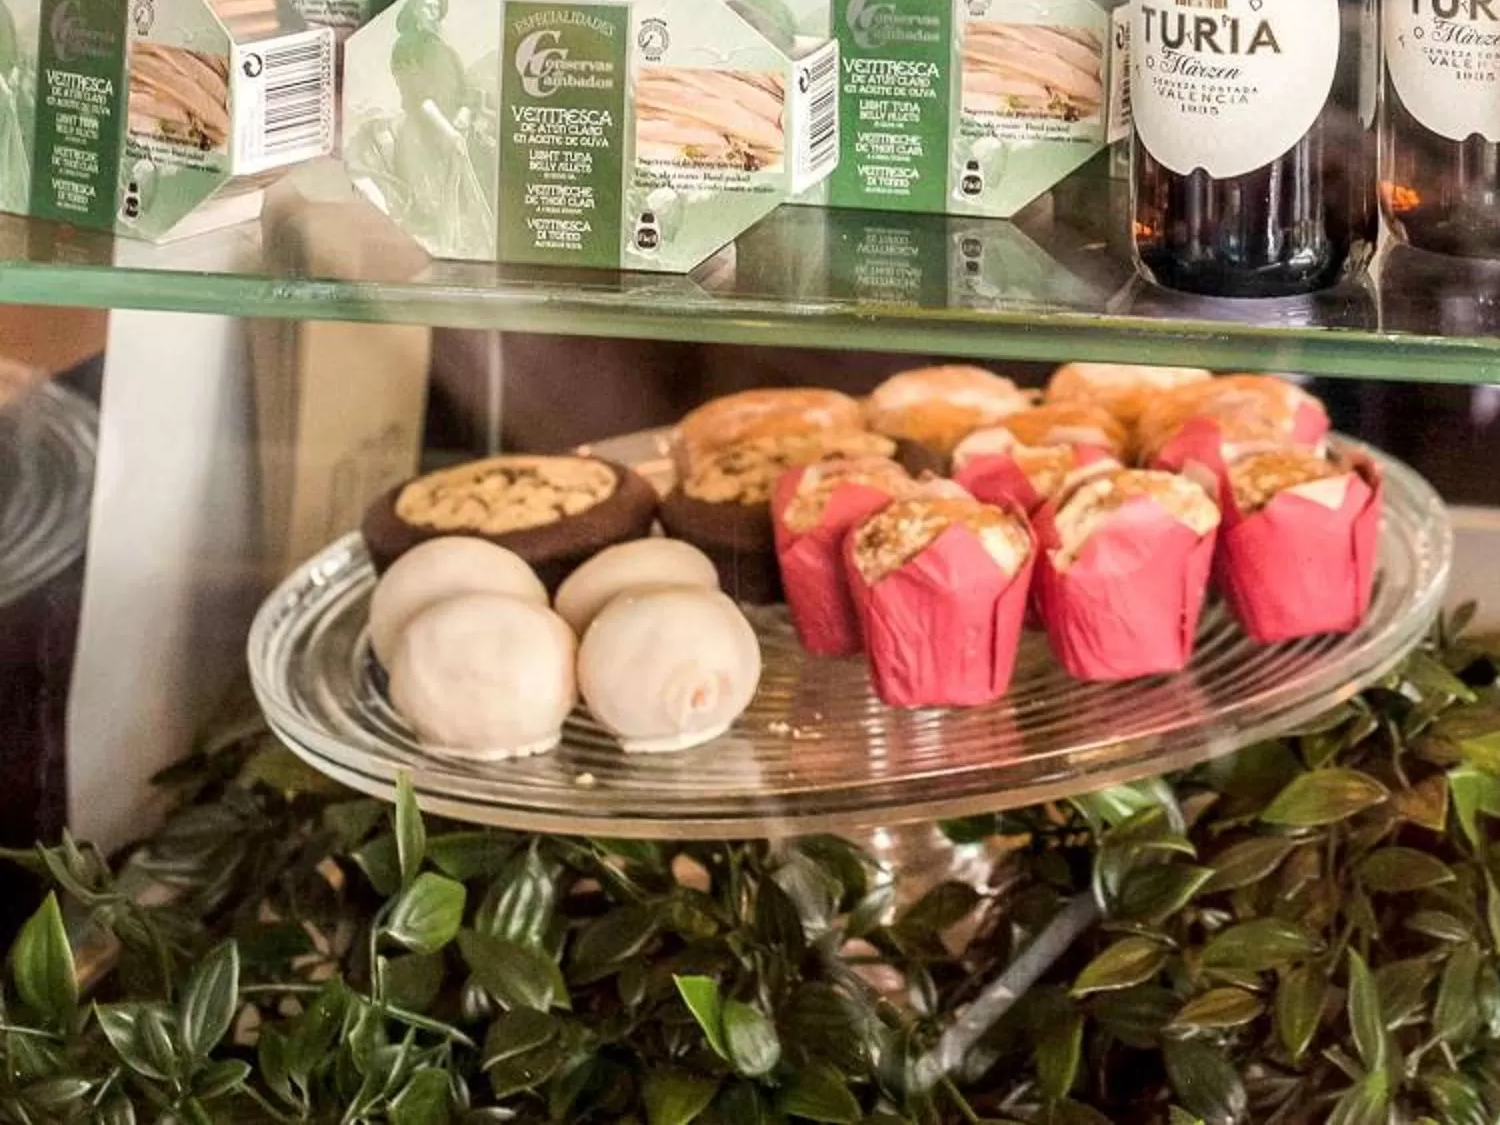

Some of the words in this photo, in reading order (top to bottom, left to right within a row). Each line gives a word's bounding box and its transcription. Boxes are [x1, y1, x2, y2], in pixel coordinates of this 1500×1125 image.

[513, 9, 617, 38] ESPECIALIDADES
[1141, 3, 1283, 56] TURIA
[842, 57, 941, 79] VENTRESCA
[1160, 43, 1246, 81] Märzen
[1155, 86, 1251, 106] VALENCIA
[510, 105, 614, 127] VENTRESCA
